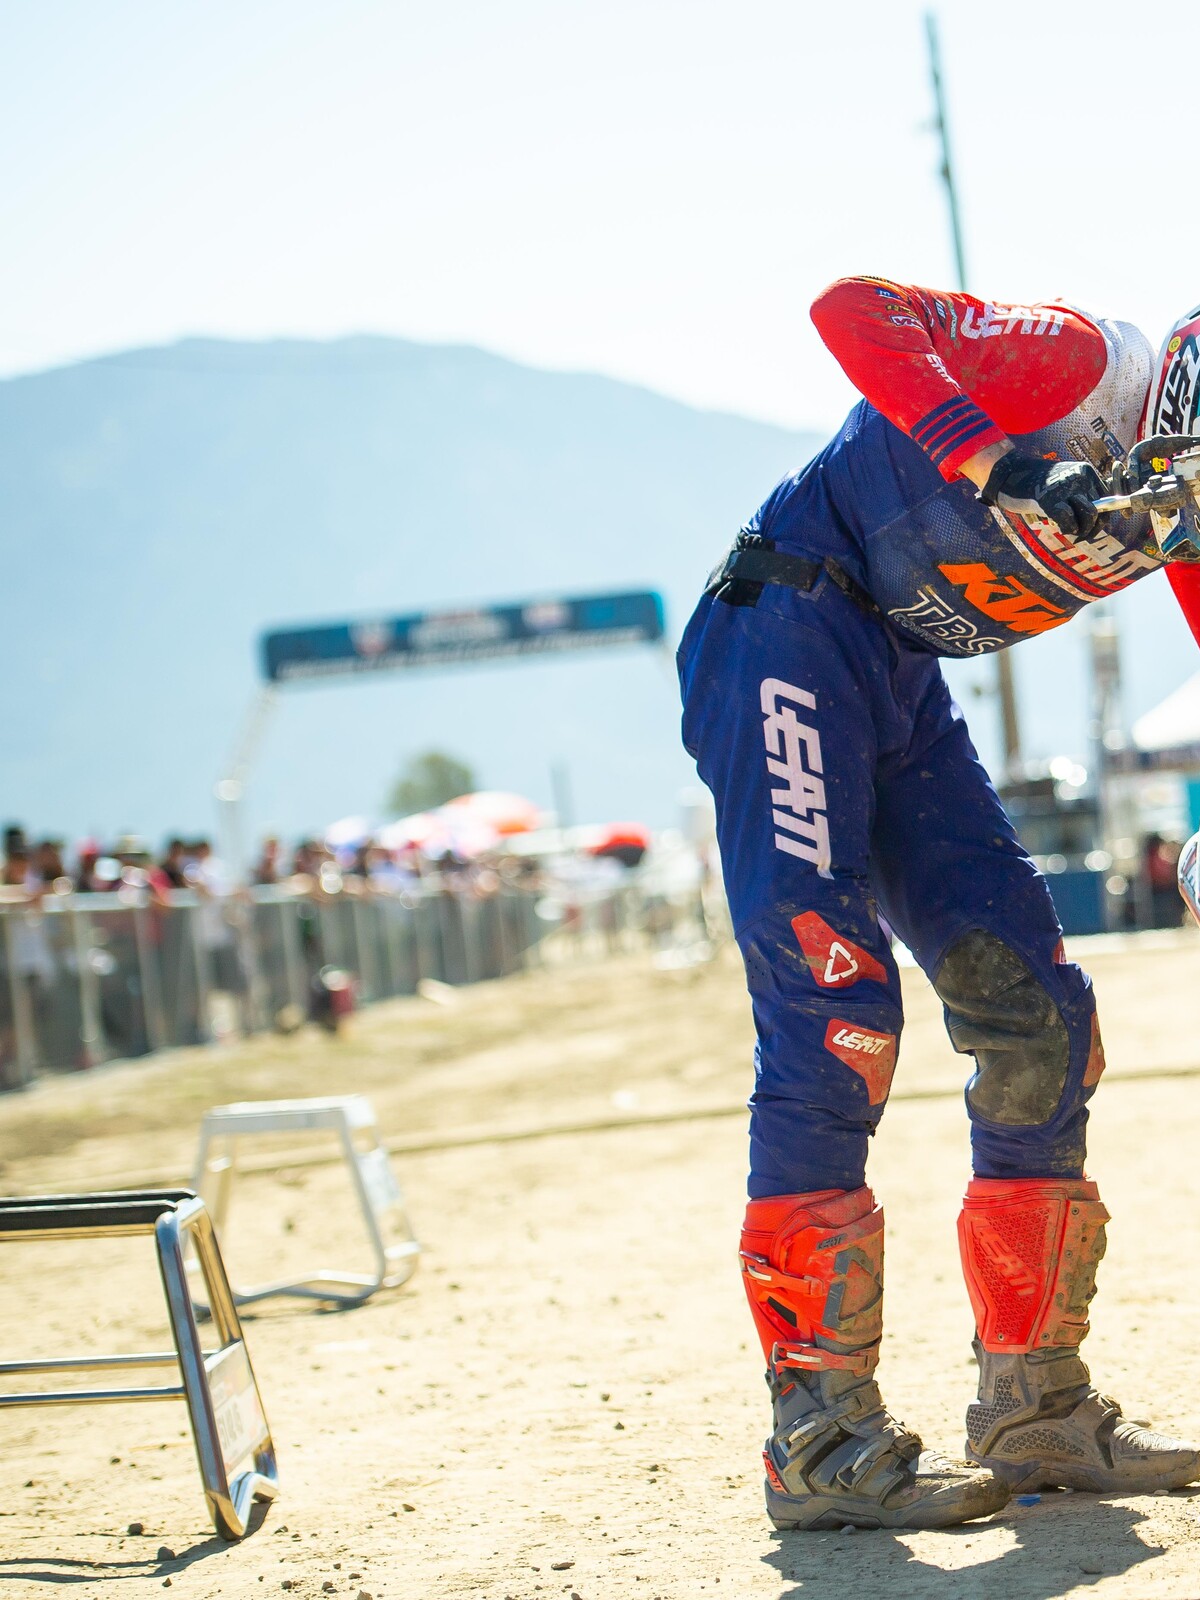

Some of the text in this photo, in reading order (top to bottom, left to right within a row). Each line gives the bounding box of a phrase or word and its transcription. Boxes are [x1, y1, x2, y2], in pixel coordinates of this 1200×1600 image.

[961, 300, 1073, 339] LEATT
[887, 585, 1004, 654] TBS
[938, 563, 1072, 635] KTM
[760, 678, 834, 879] LEATT
[832, 1028, 891, 1055] LEATT
